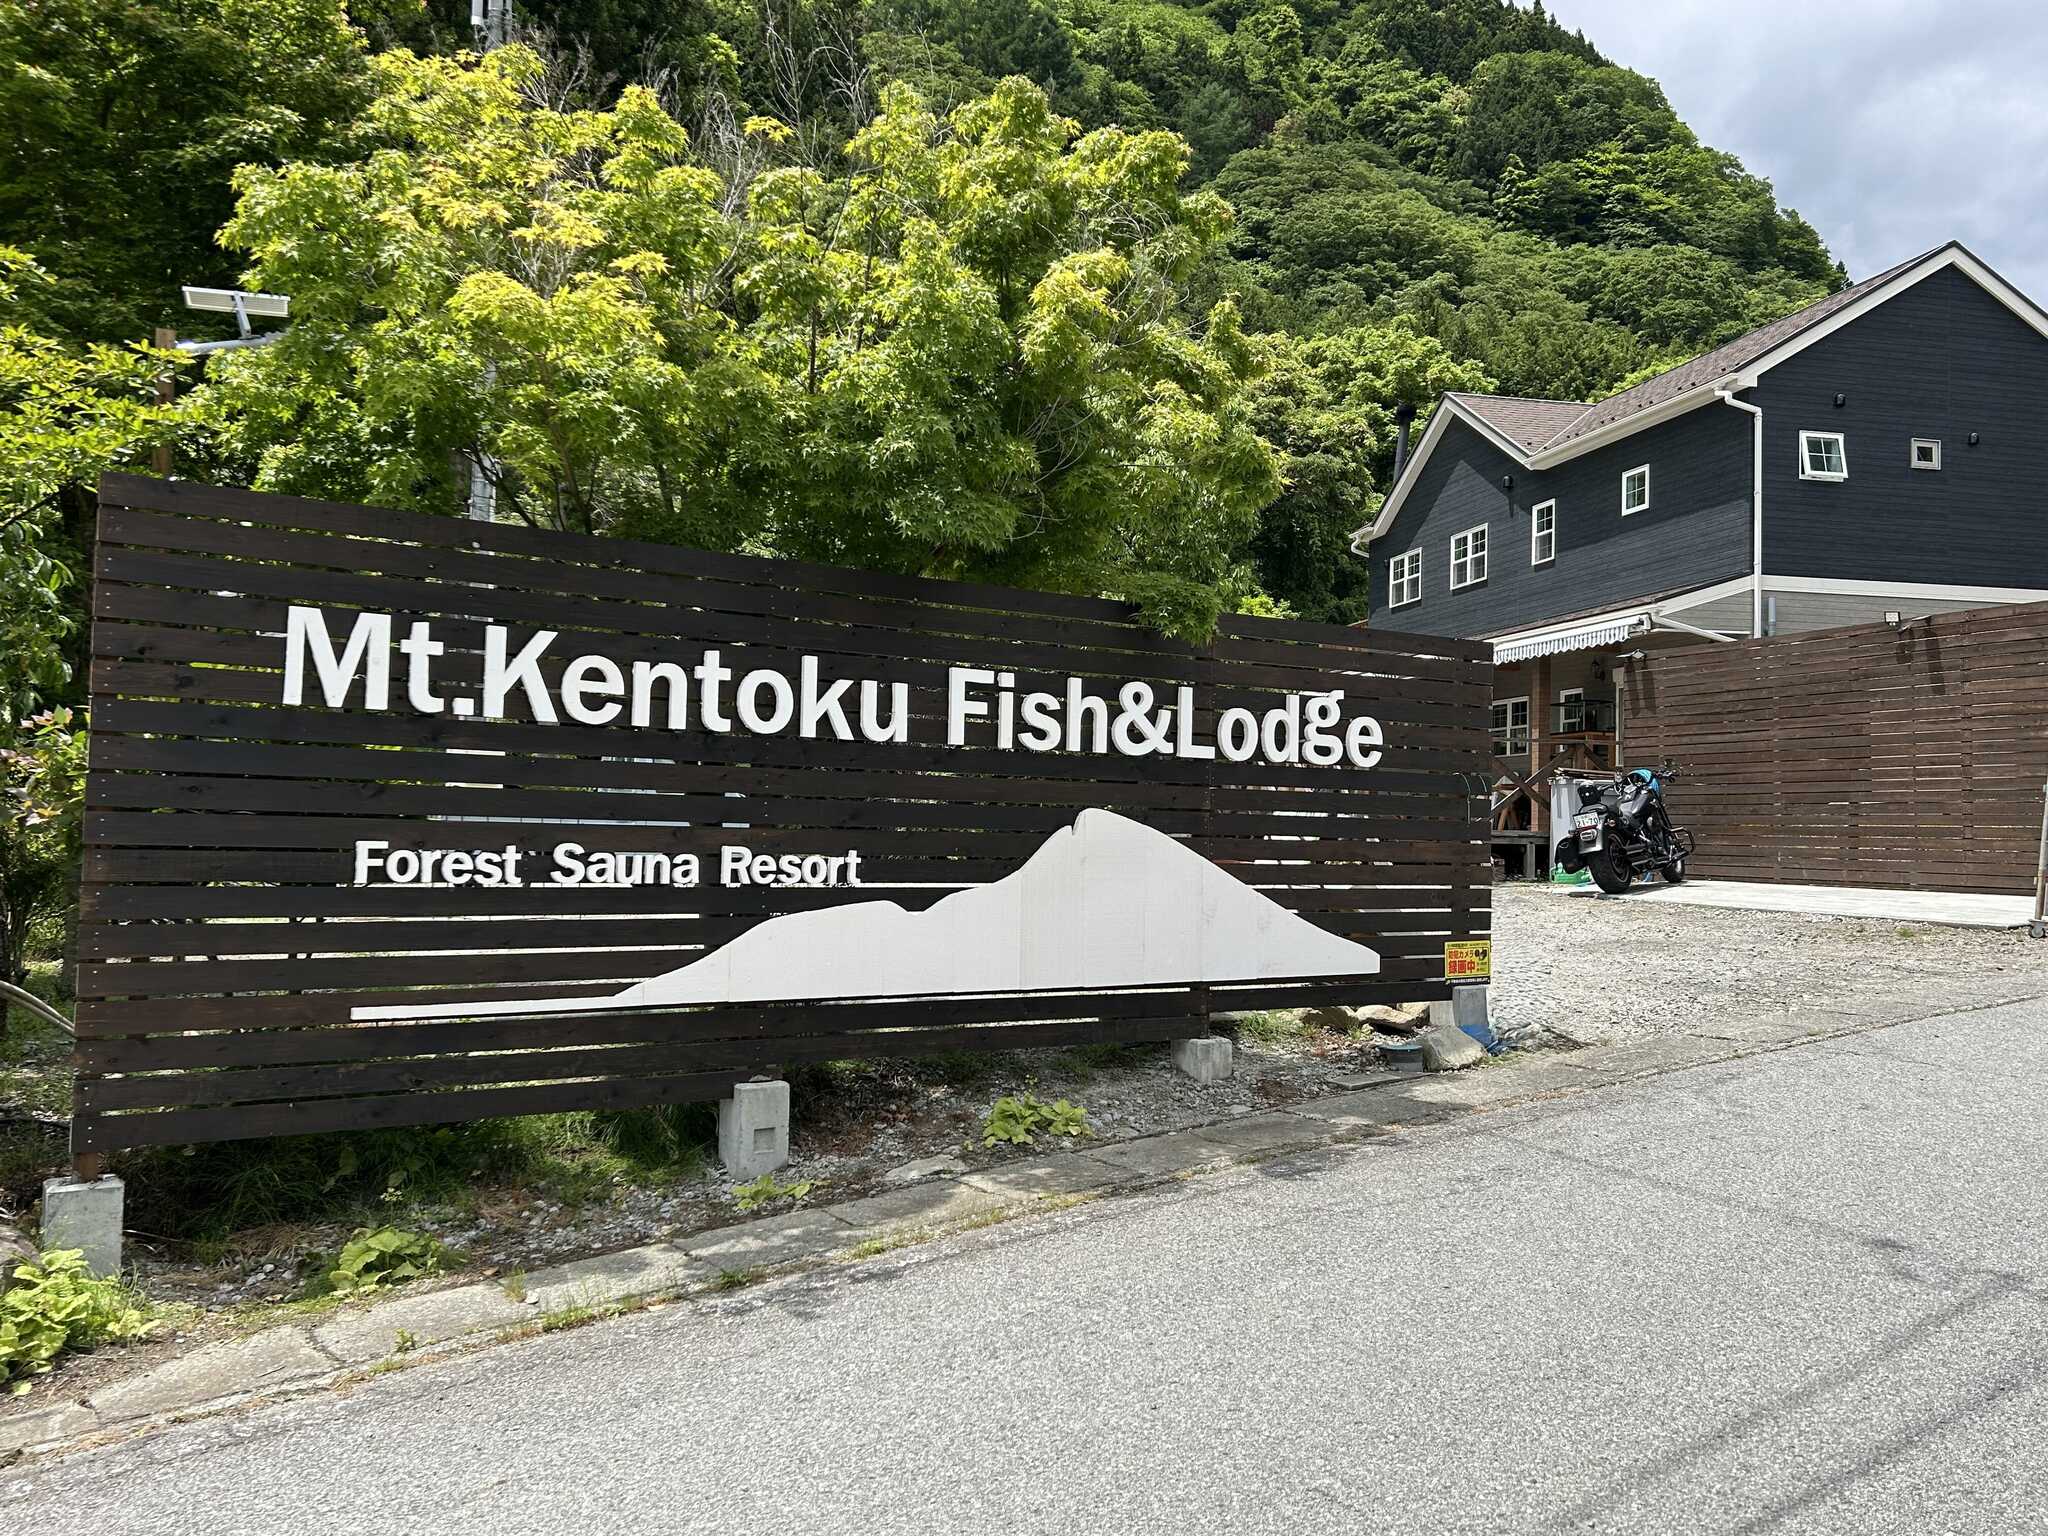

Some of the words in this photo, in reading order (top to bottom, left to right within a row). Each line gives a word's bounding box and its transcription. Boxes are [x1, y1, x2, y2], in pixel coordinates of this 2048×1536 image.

[281, 605, 909, 743] Mt.Kentoku
[946, 666, 1384, 768] Fish&Lodge
[353, 840, 522, 884] Forest
[550, 842, 700, 885] Sauna
[720, 845, 862, 884] Resort
